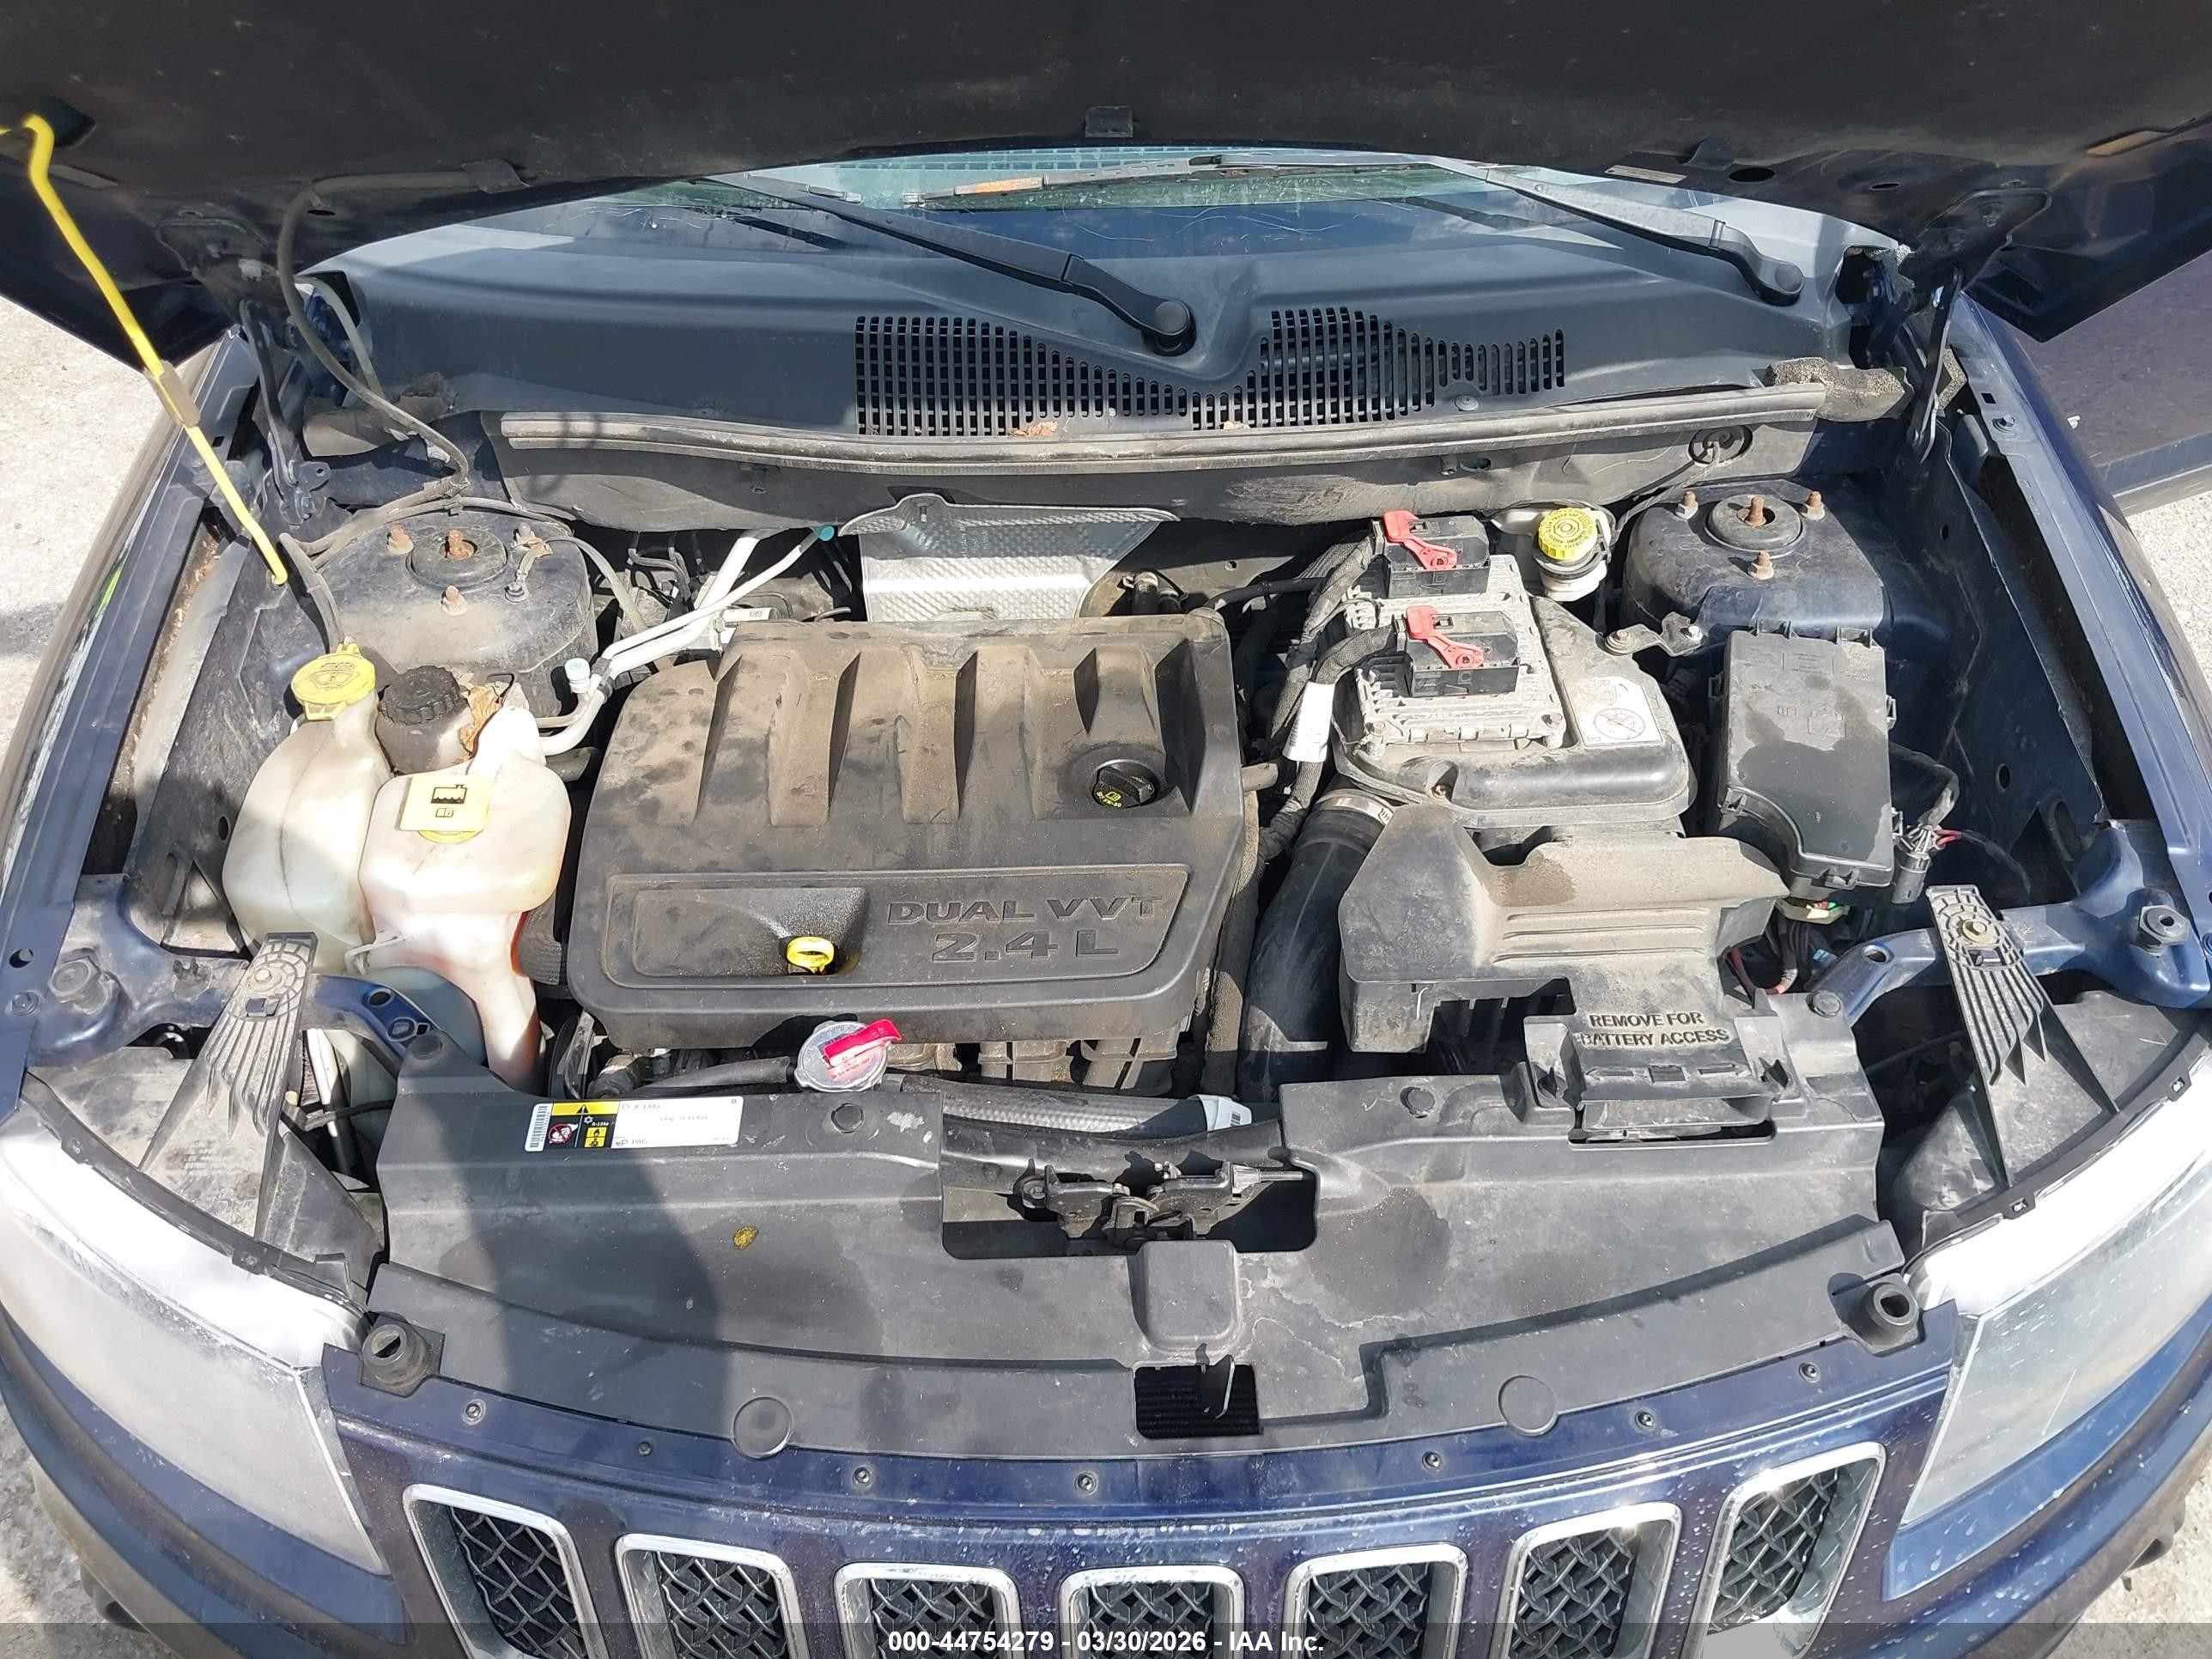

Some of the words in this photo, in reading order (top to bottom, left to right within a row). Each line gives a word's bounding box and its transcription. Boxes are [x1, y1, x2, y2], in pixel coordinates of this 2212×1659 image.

[887, 900, 1036, 926] DUAL
[1046, 896, 1163, 921] VVT
[932, 929, 1059, 963] 2.4
[1075, 929, 1119, 958] L
[1589, 1012, 1664, 1028] REMOVE
[1666, 1011, 1705, 1025] FOR
[1578, 1031, 1656, 1047] BATTERY
[1660, 1029, 1731, 1046] ACCESS
